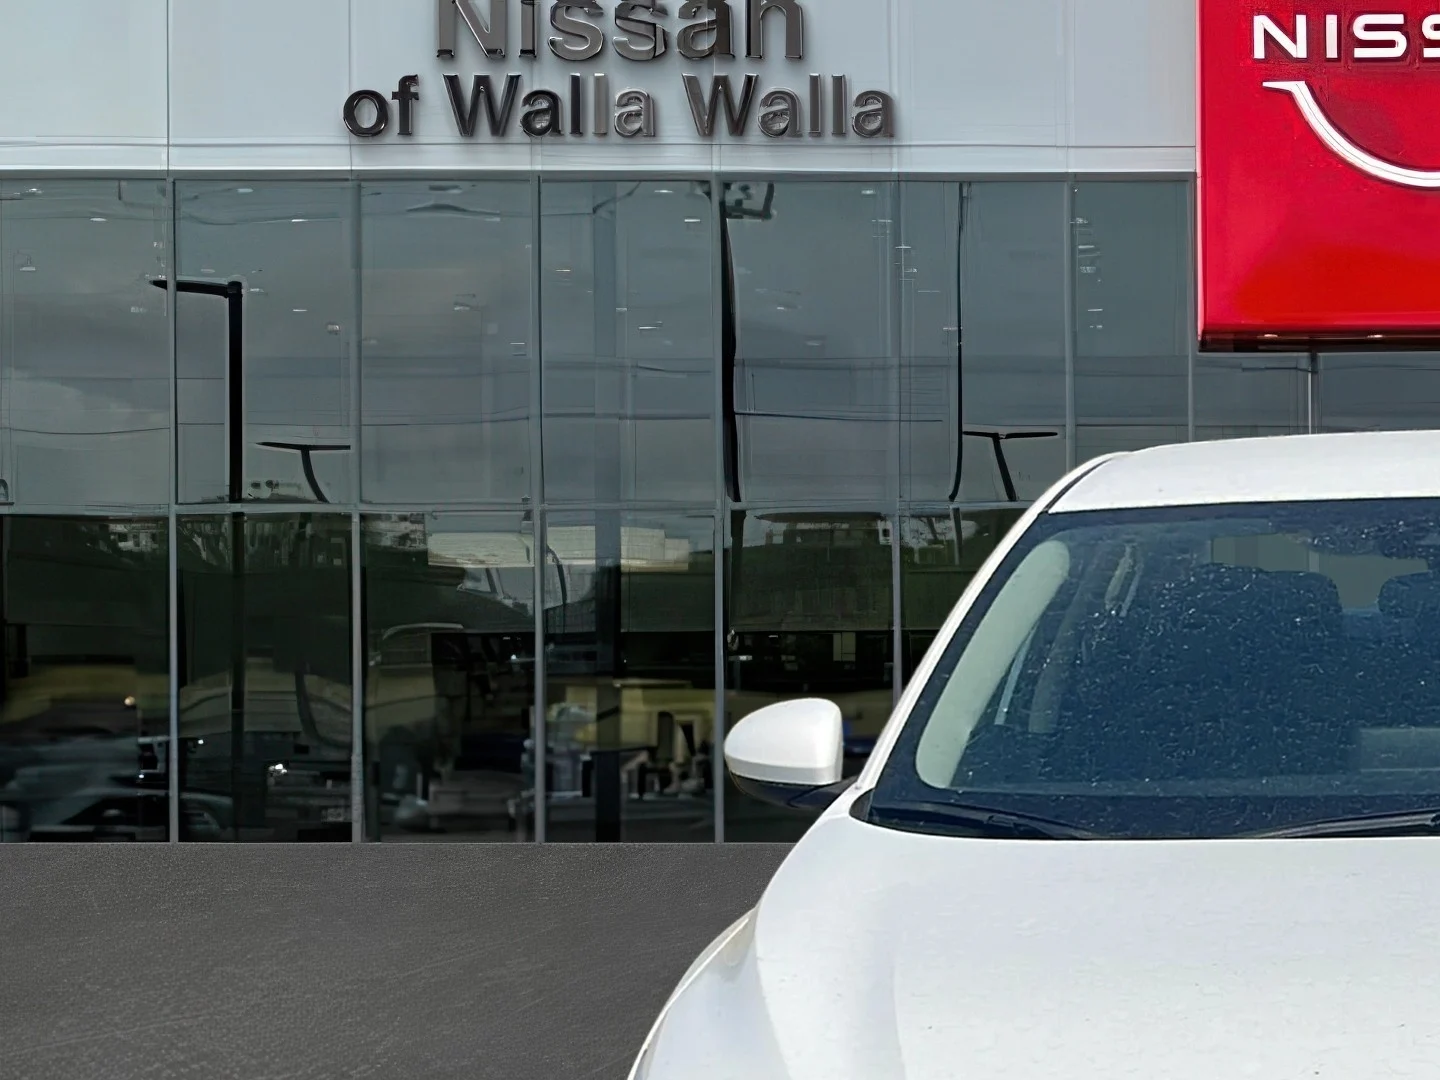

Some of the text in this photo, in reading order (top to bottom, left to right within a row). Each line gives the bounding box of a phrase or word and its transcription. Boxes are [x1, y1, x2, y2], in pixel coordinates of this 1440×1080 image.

[435, 0, 804, 60] Nissan
[343, 73, 895, 138] of Walla Walla
